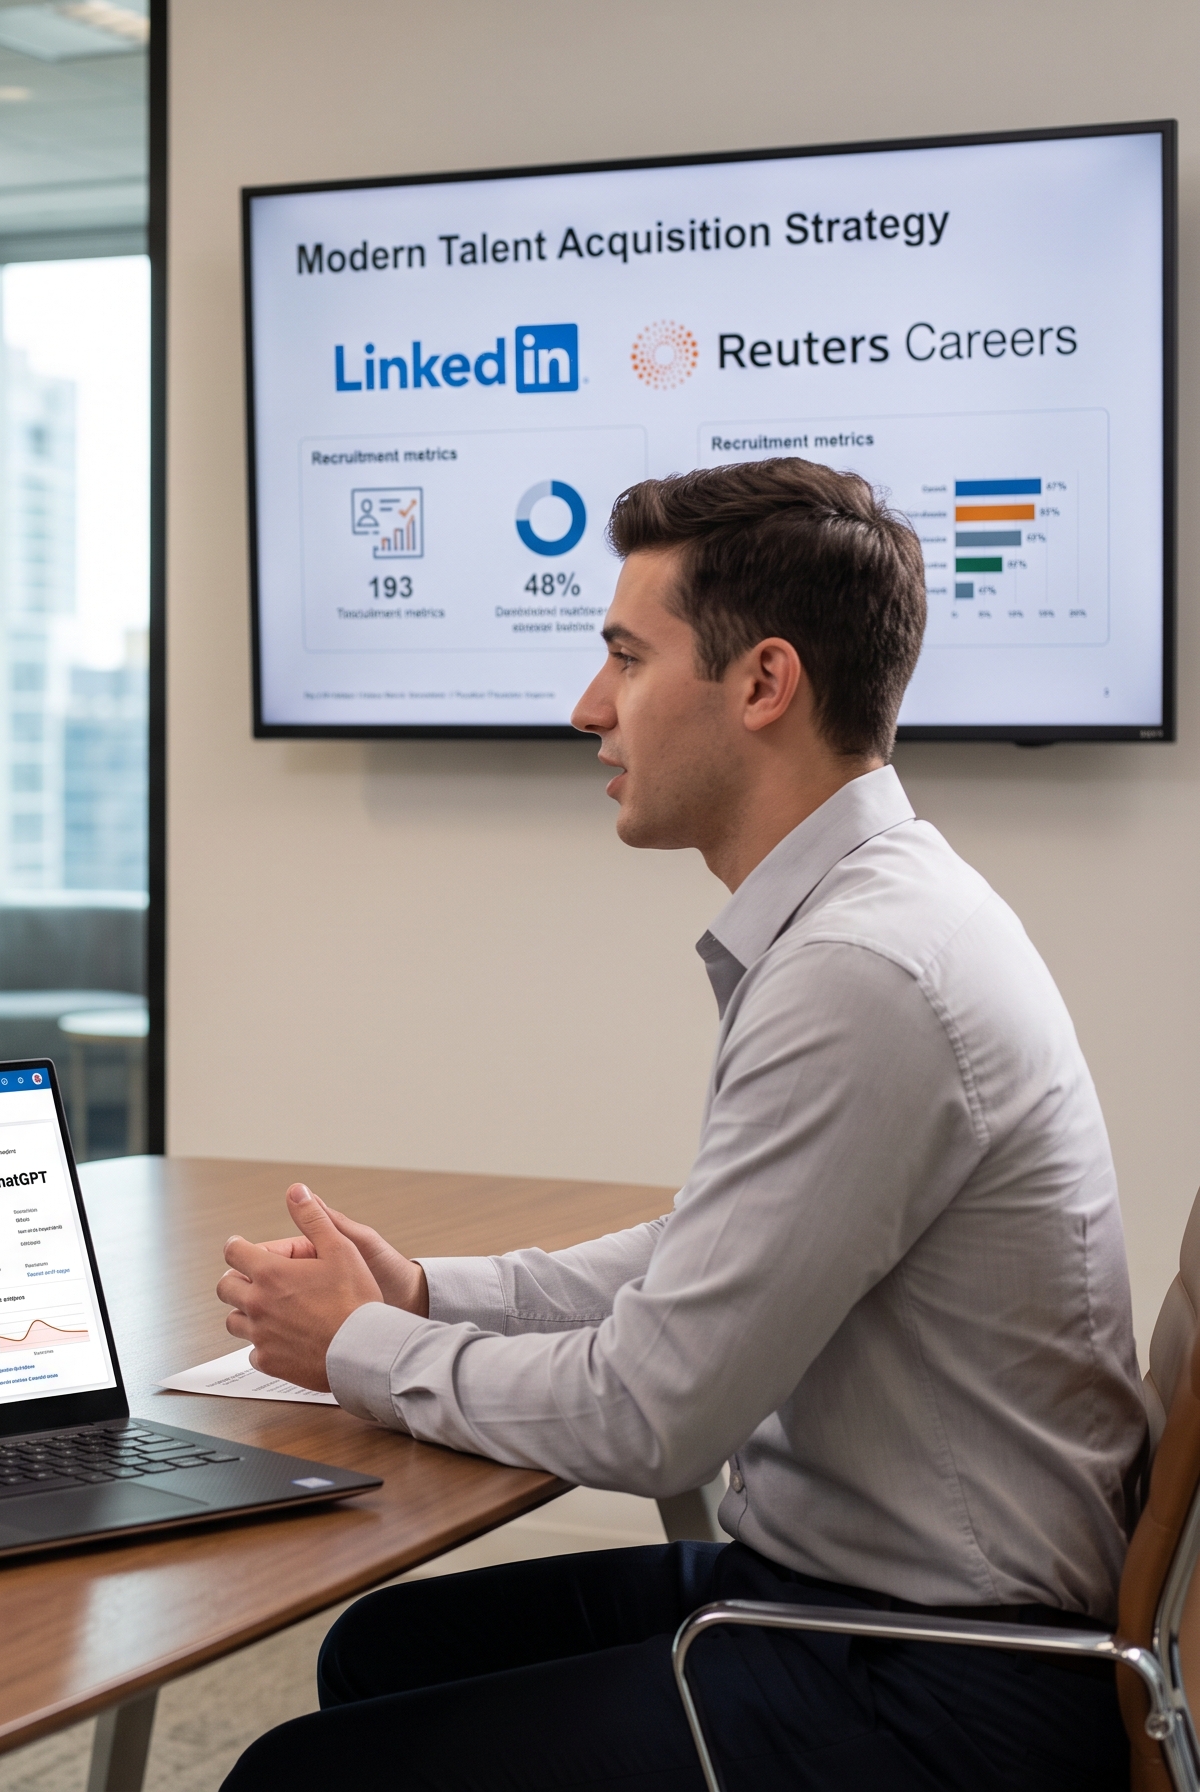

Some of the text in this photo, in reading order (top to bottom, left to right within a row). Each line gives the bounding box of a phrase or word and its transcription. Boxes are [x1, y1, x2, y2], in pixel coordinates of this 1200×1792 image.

[296, 209, 950, 276] Modern Talent Acquisition Strategy
[718, 322, 1078, 370] Reuters Careers
[711, 432, 875, 452] Recruitment metrics
[311, 447, 458, 466] Recruitment metrics
[369, 575, 414, 599] 193
[524, 571, 581, 597] 48%
